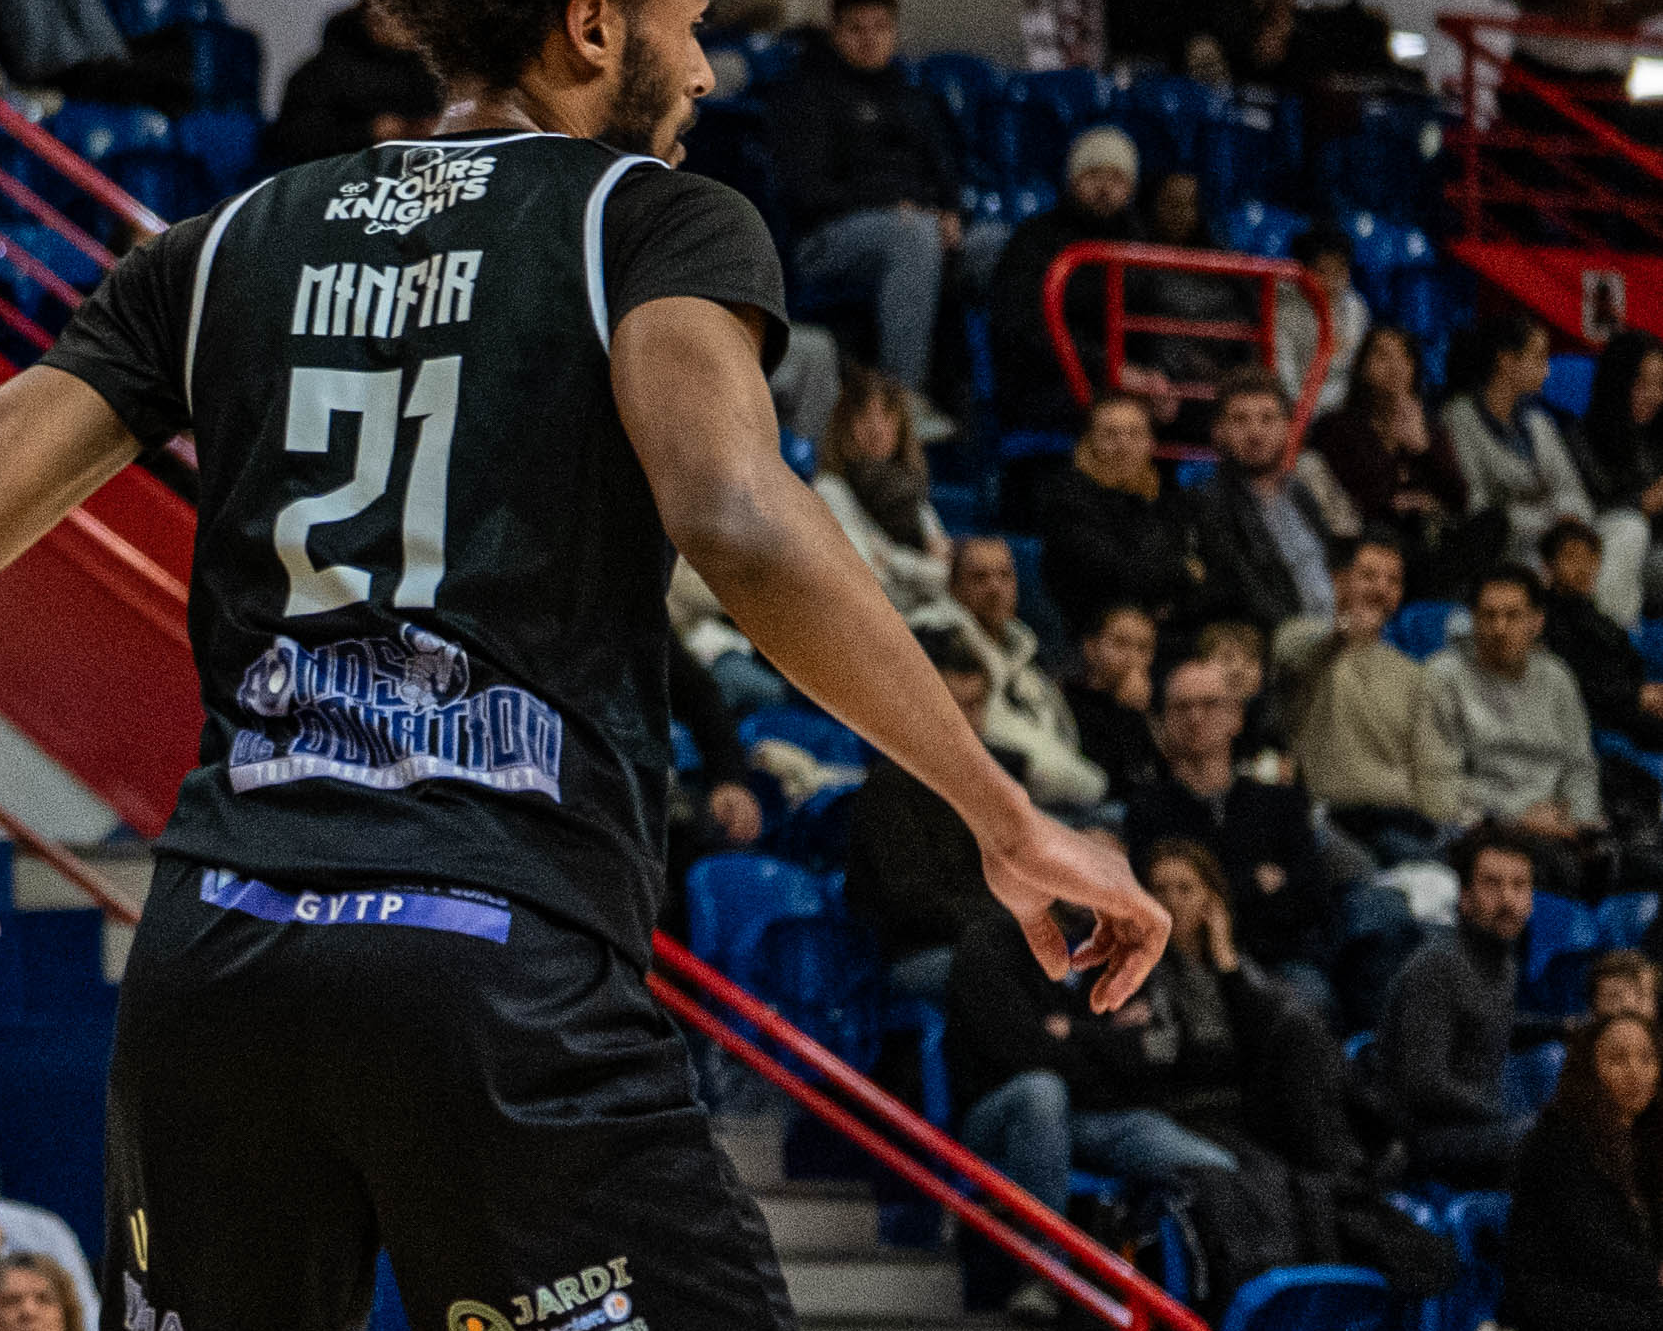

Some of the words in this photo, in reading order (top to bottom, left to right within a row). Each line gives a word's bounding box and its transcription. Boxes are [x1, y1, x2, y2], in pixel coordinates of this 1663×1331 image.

[324, 176, 490, 223] KNIGHTS
[375, 155, 498, 217] TOURS
[290, 249, 484, 339] MINFIR
[273, 354, 463, 618] 21
[293, 891, 404, 921] GVTP
[510, 1256, 634, 1326] JARDI
